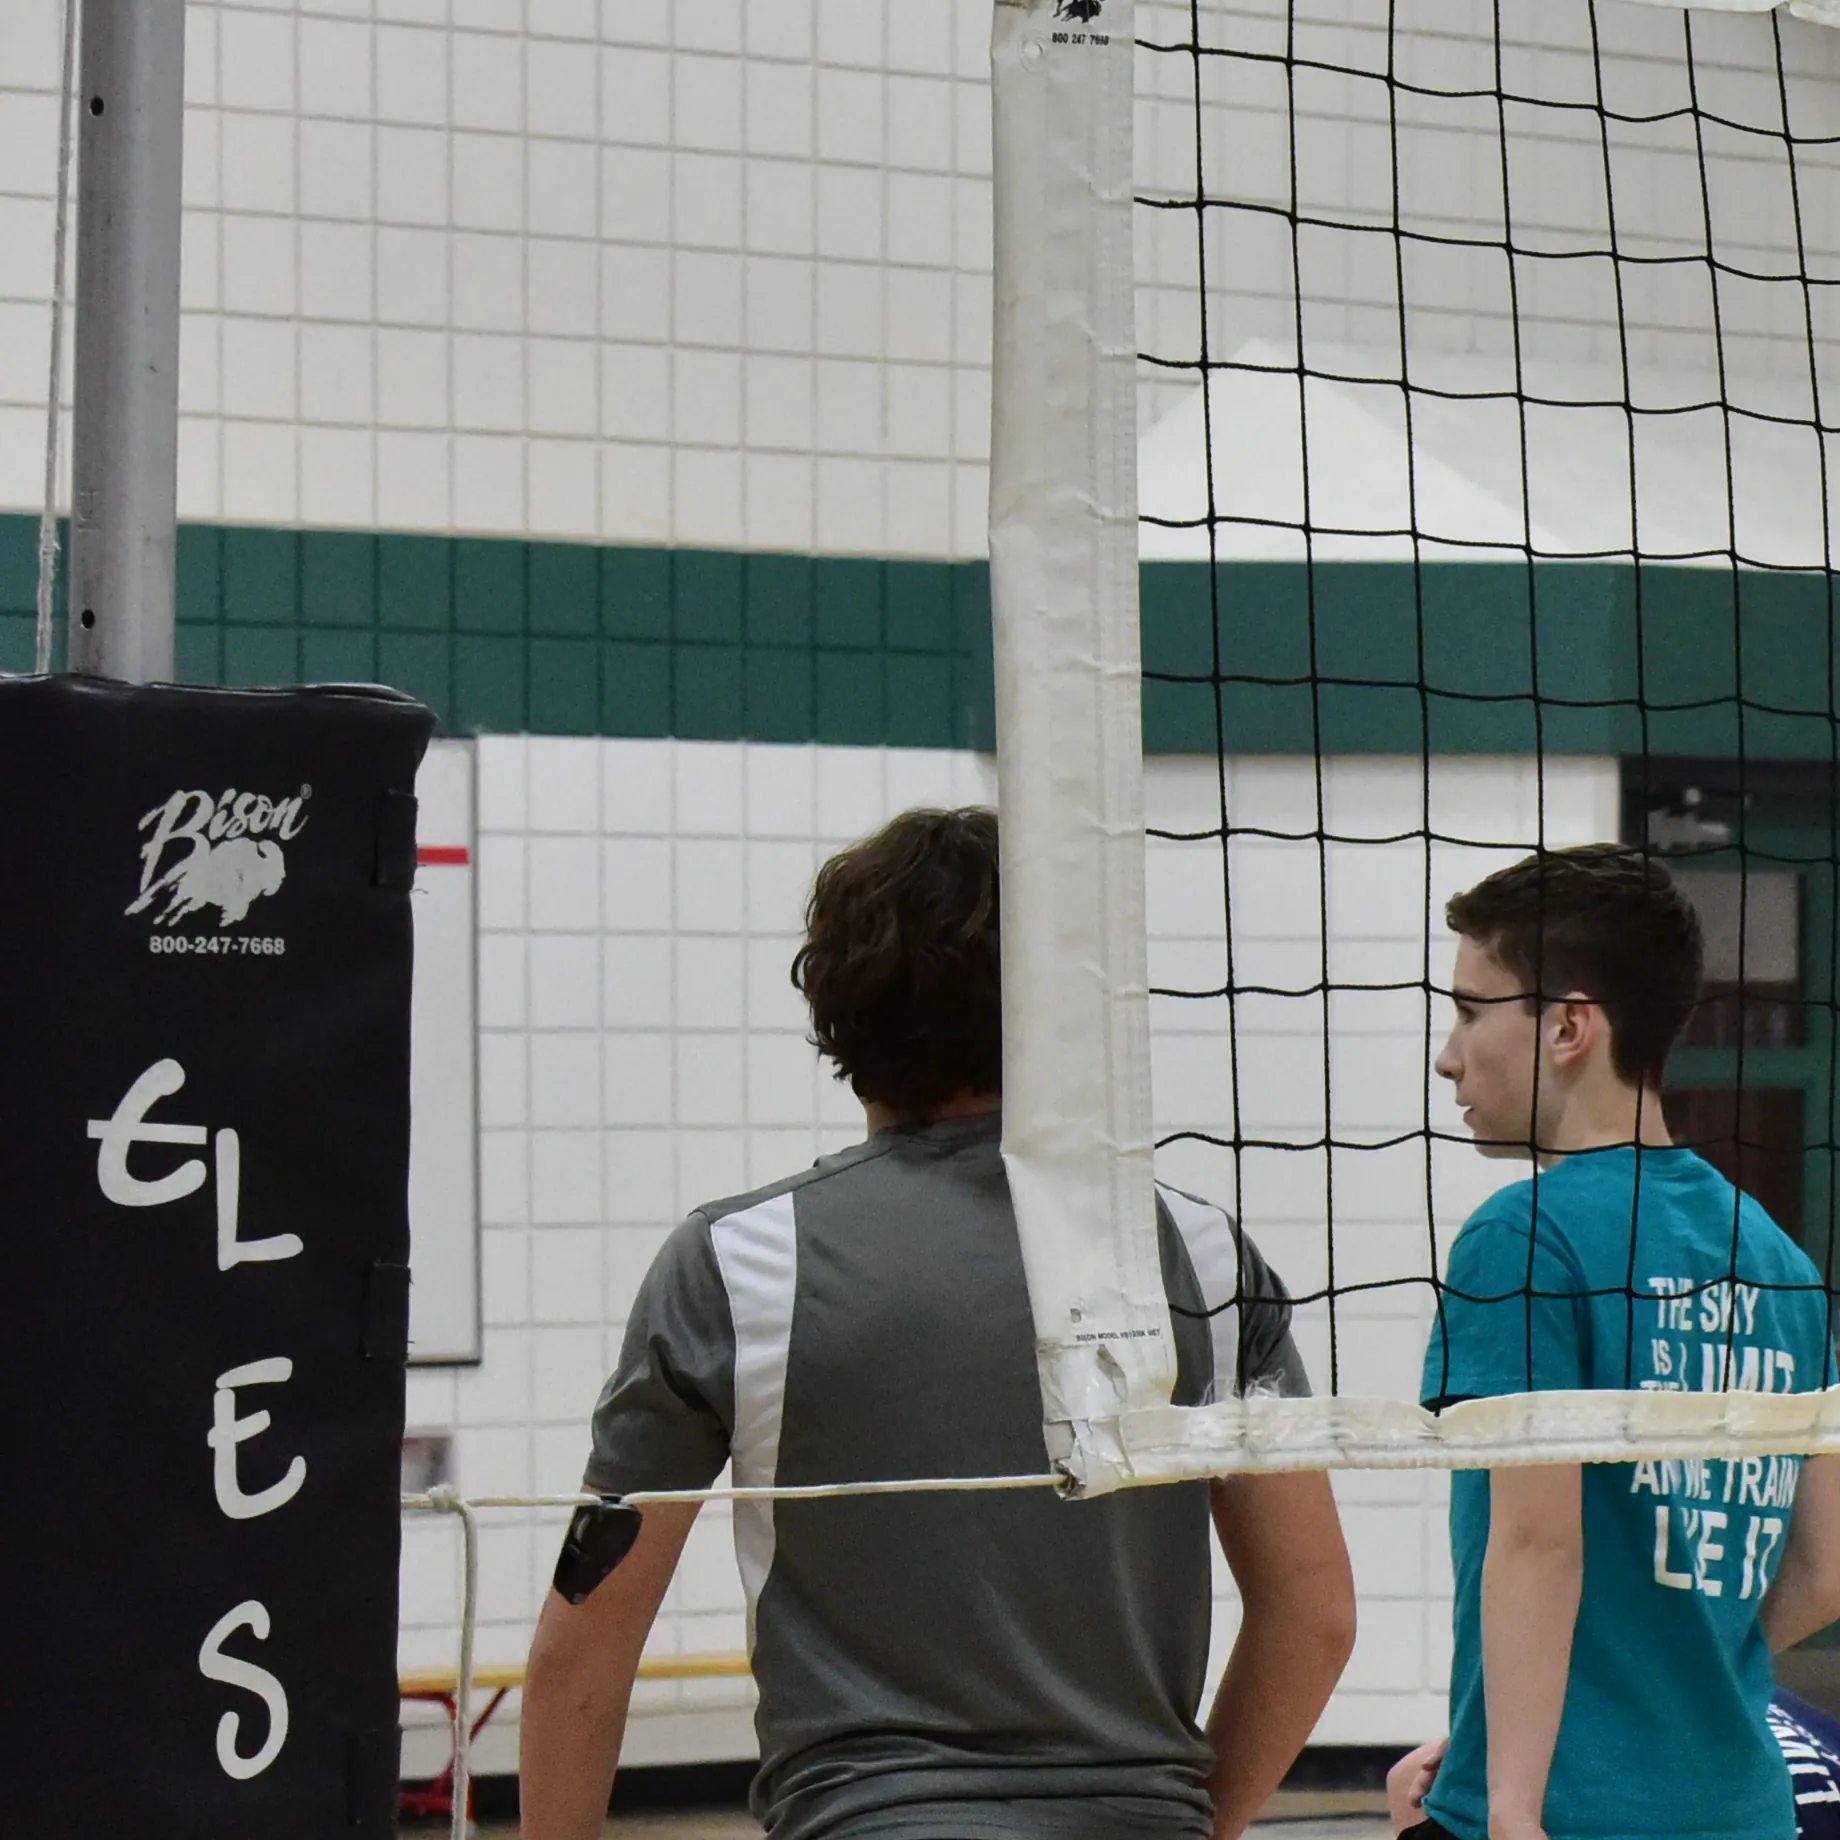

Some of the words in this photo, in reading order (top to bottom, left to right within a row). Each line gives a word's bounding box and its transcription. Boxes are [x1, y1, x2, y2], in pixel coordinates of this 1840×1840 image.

[149, 936, 286, 955] 800-247-7668
[1648, 1277, 1694, 1331] THE
[1700, 1279, 1760, 1336] SKY
[1651, 1339, 1673, 1376] IS
[1739, 1516, 1783, 1600] IT
